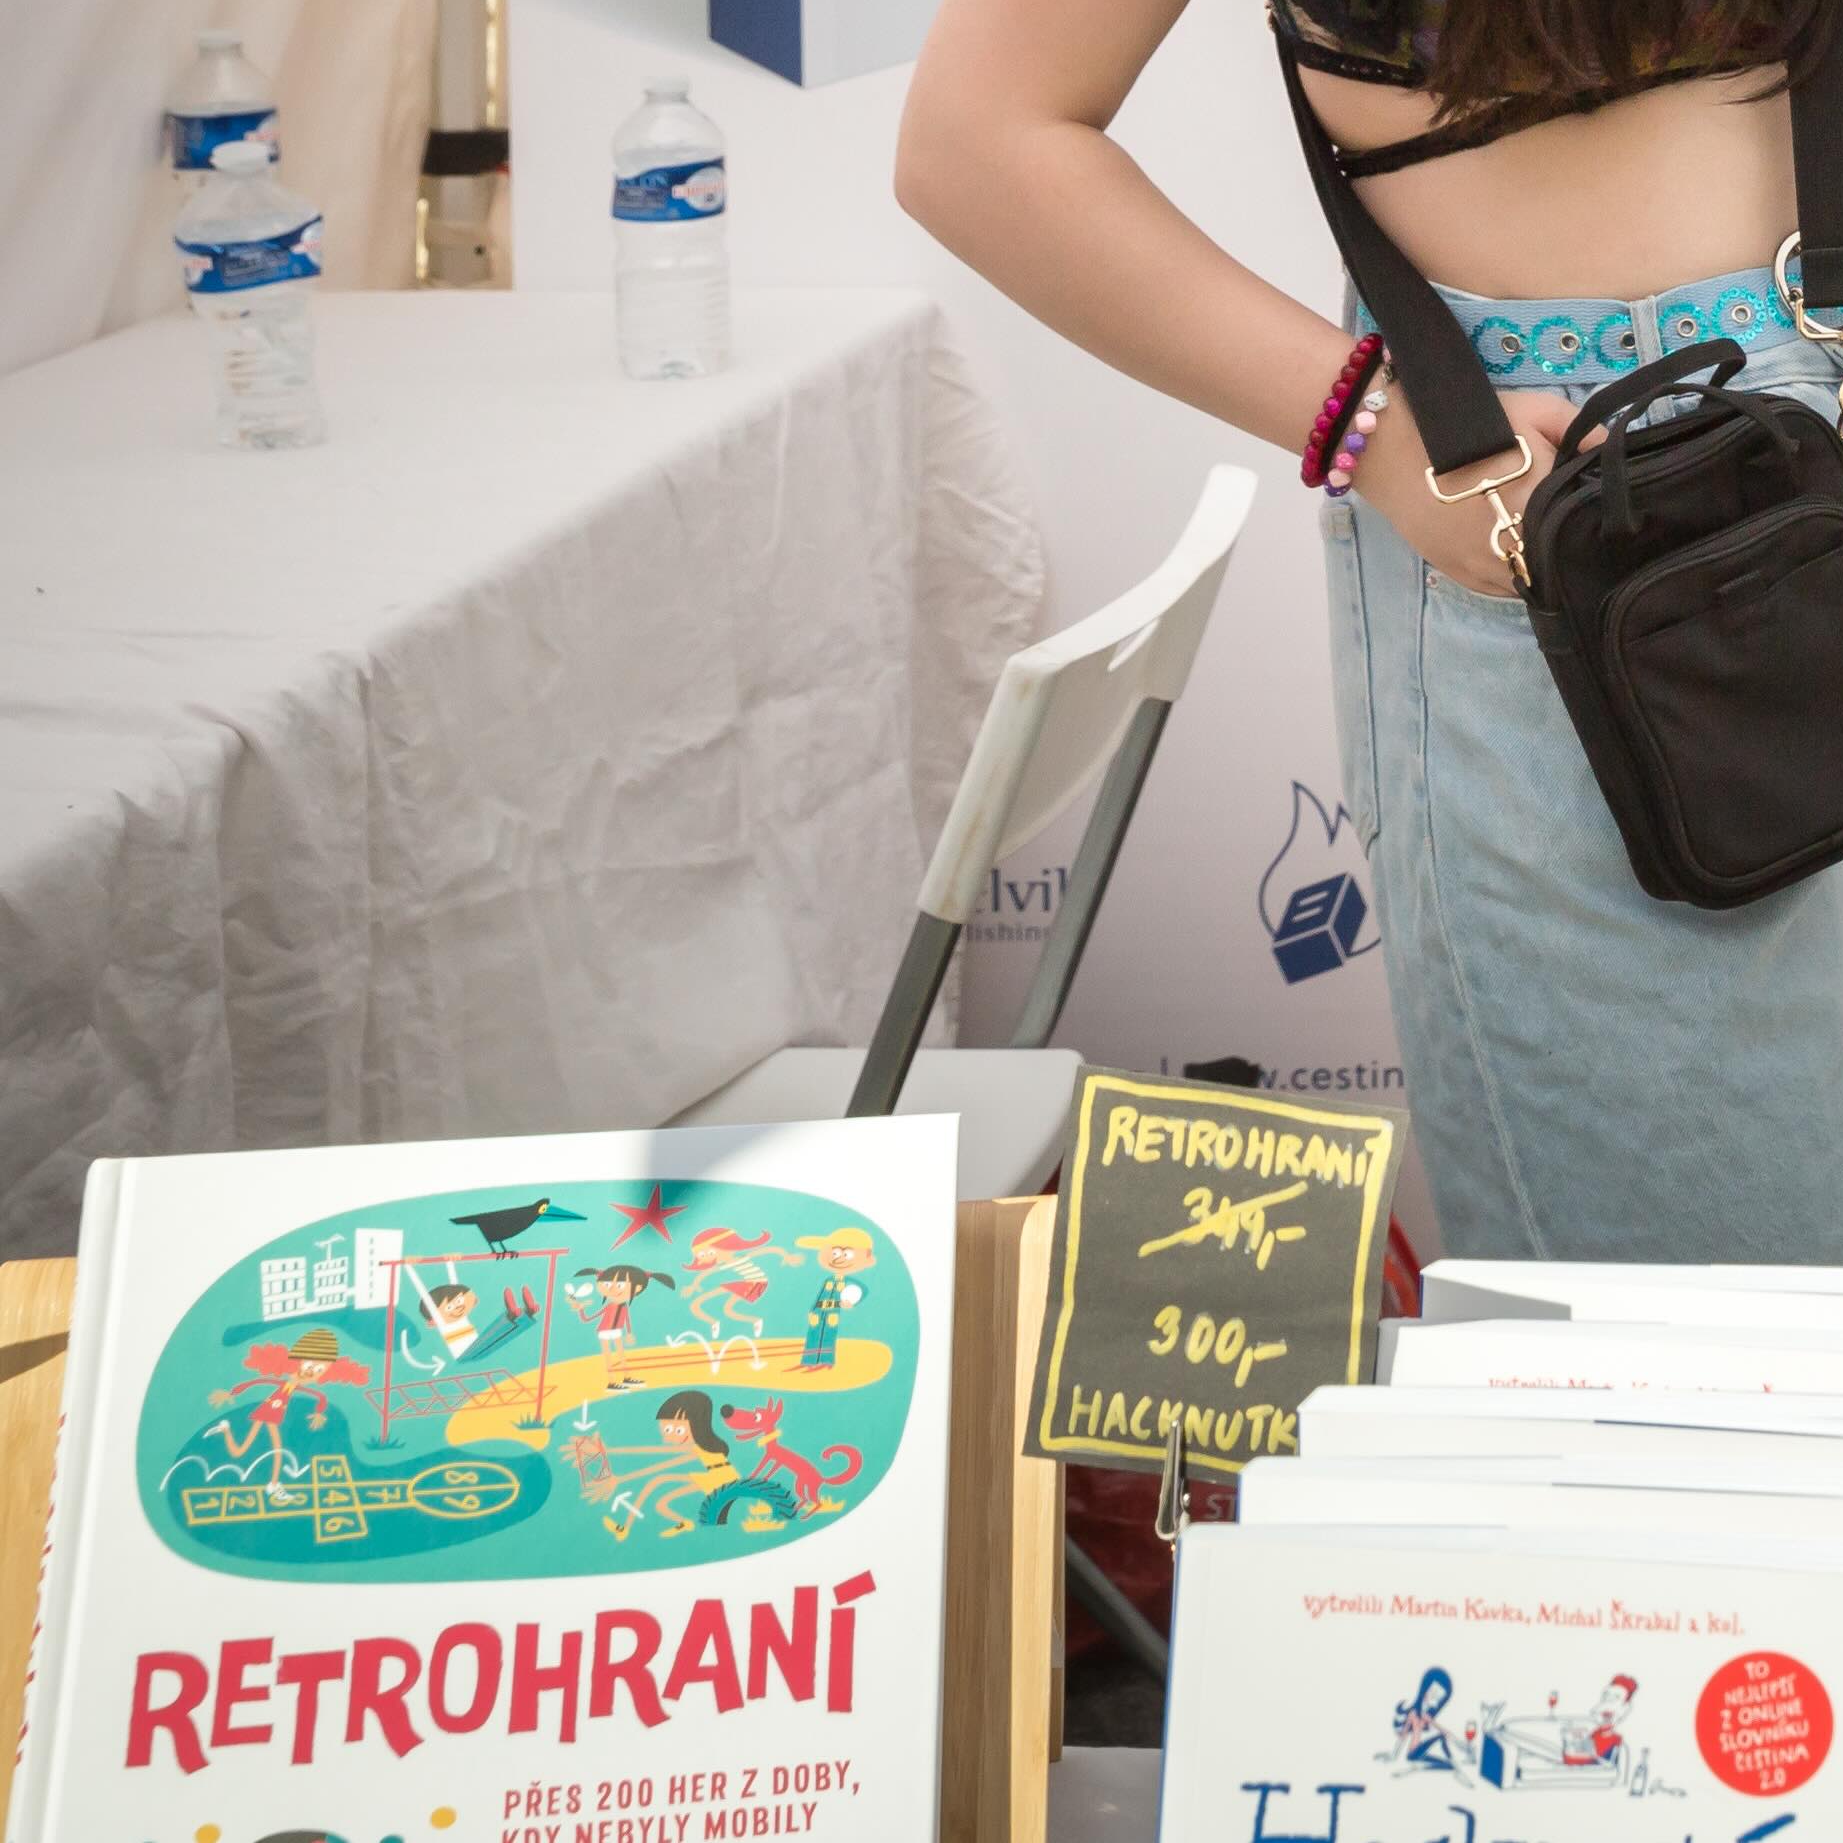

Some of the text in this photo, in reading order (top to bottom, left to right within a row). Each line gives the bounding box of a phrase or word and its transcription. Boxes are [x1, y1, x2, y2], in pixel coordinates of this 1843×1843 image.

[1390, 1594, 1458, 1618] Martin
[1465, 1597, 1531, 1625] Kavka,
[1537, 1603, 1603, 1629] Michal
[1610, 1598, 1680, 1634] Škrabal
[1688, 1618, 1700, 1634] a
[1708, 1612, 1746, 1636] kol.
[125, 1569, 877, 1774] RETROHRANÍ
[1744, 1660, 1771, 1680] TO
[504, 1759, 862, 1820] PŘES 200 HER Z DOBY,
[704, 1801, 818, 1841] MOBILY
